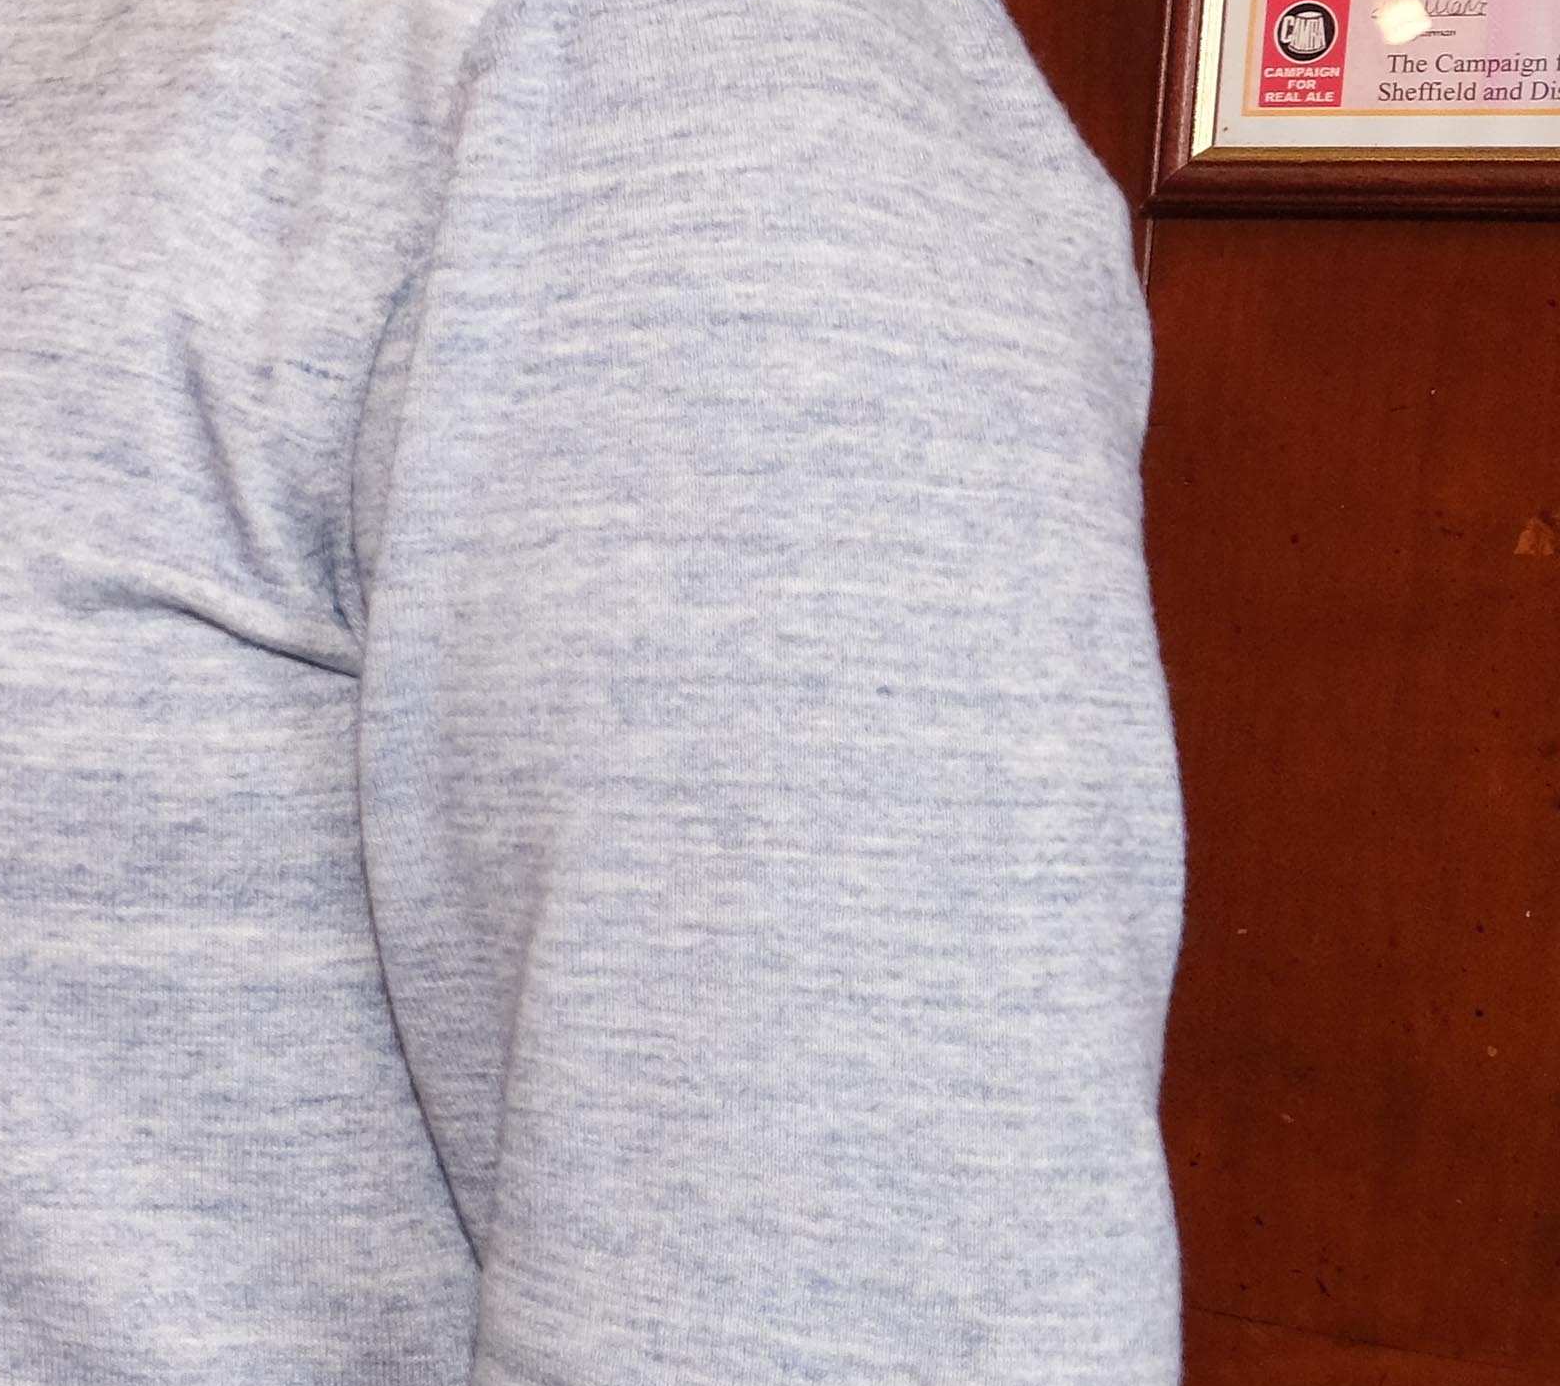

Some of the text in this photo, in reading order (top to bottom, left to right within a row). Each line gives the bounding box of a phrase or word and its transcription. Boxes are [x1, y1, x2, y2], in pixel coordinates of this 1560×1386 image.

[1263, 66, 1341, 79] CAMPAIGN
[1386, 53, 1549, 80] The Campaign
[1286, 79, 1317, 91] FOR
[1377, 81, 1477, 102] Sheffield
[1482, 82, 1527, 102] and
[1264, 91, 1336, 104] REAL ALE
